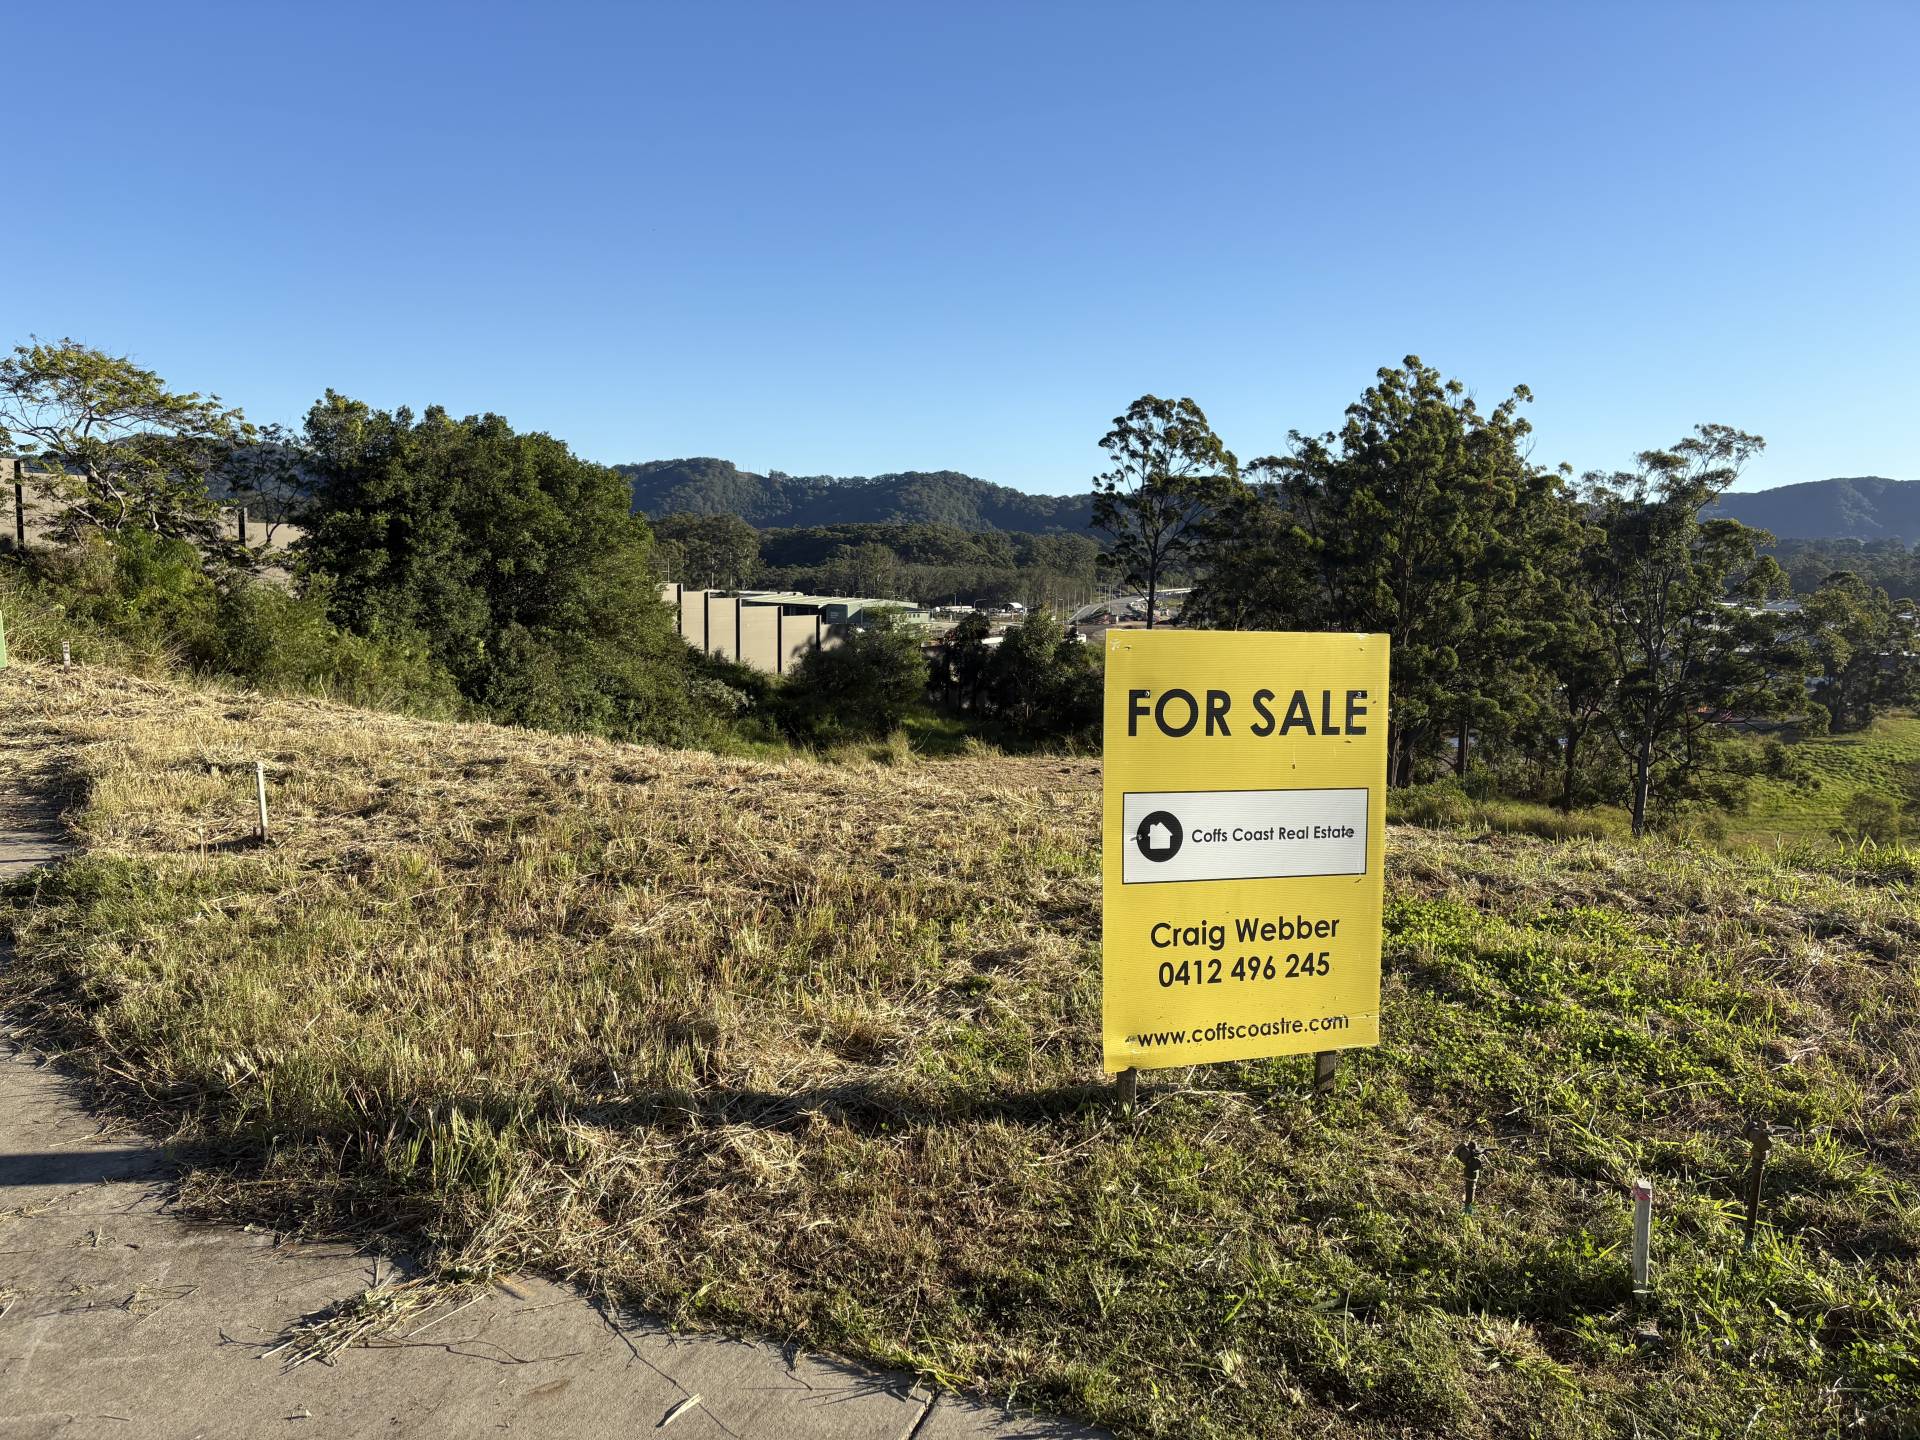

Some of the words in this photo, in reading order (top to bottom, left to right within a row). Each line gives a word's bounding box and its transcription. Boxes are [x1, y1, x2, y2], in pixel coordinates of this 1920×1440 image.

[1127, 688, 1232, 738] FOR
[1250, 688, 1368, 738] SALE
[1191, 828, 1228, 843] Coffs
[1232, 827, 1275, 842] Coast
[1278, 825, 1309, 840] Real
[1313, 824, 1355, 839] Estate
[1150, 919, 1225, 951] Craig
[1234, 914, 1340, 943] Webber
[1158, 958, 1222, 988] 0412
[1230, 955, 1276, 982] 496
[1284, 951, 1330, 979] 245
[1137, 1014, 1350, 1047] www.coffscoastre.com
